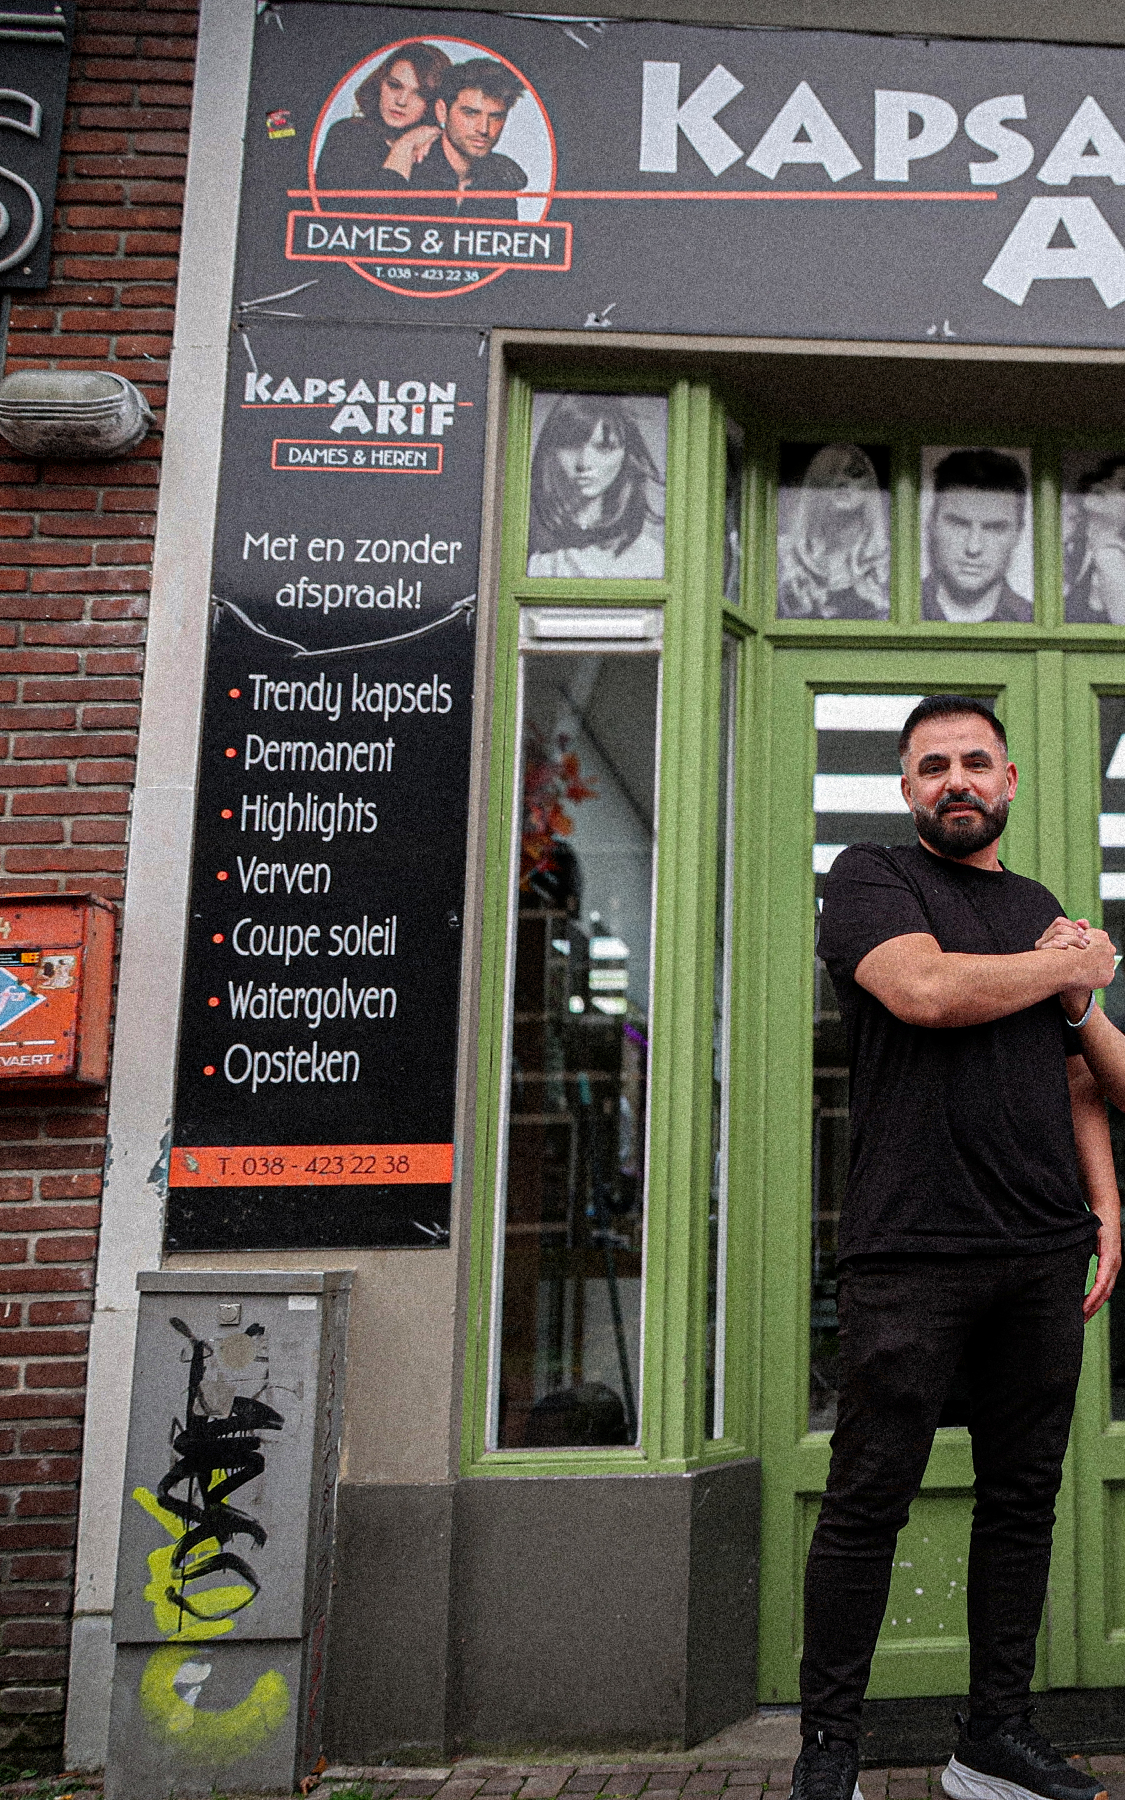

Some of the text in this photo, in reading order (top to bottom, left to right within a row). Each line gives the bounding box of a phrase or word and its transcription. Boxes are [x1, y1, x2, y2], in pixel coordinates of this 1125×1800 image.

[307, 223, 550, 258] DAMES & HEREN
[387, 267, 411, 280] 038
[421, 268, 443, 281] 423
[446, 269, 462, 281] 22
[464, 269, 479, 282] 38
[244, 372, 457, 403] KAPSALON
[288, 447, 427, 467] DAMES & HEREN
[242, 532, 462, 564] Met en zonder
[276, 576, 422, 614] afspraak!
[249, 672, 452, 722] Trendy kapsels
[244, 734, 395, 772] Permanent
[240, 792, 378, 842] Highlights
[236, 855, 331, 894] Verven
[232, 915, 397, 966] Coupe soleil
[228, 977, 397, 1029] Watergolven
[223, 1041, 360, 1094] Opsteken
[218, 1157, 235, 1176] T.
[242, 1157, 284, 1176] 038
[304, 1156, 344, 1175] 423
[349, 1156, 376, 1174] 22
[383, 1155, 410, 1173] 38
